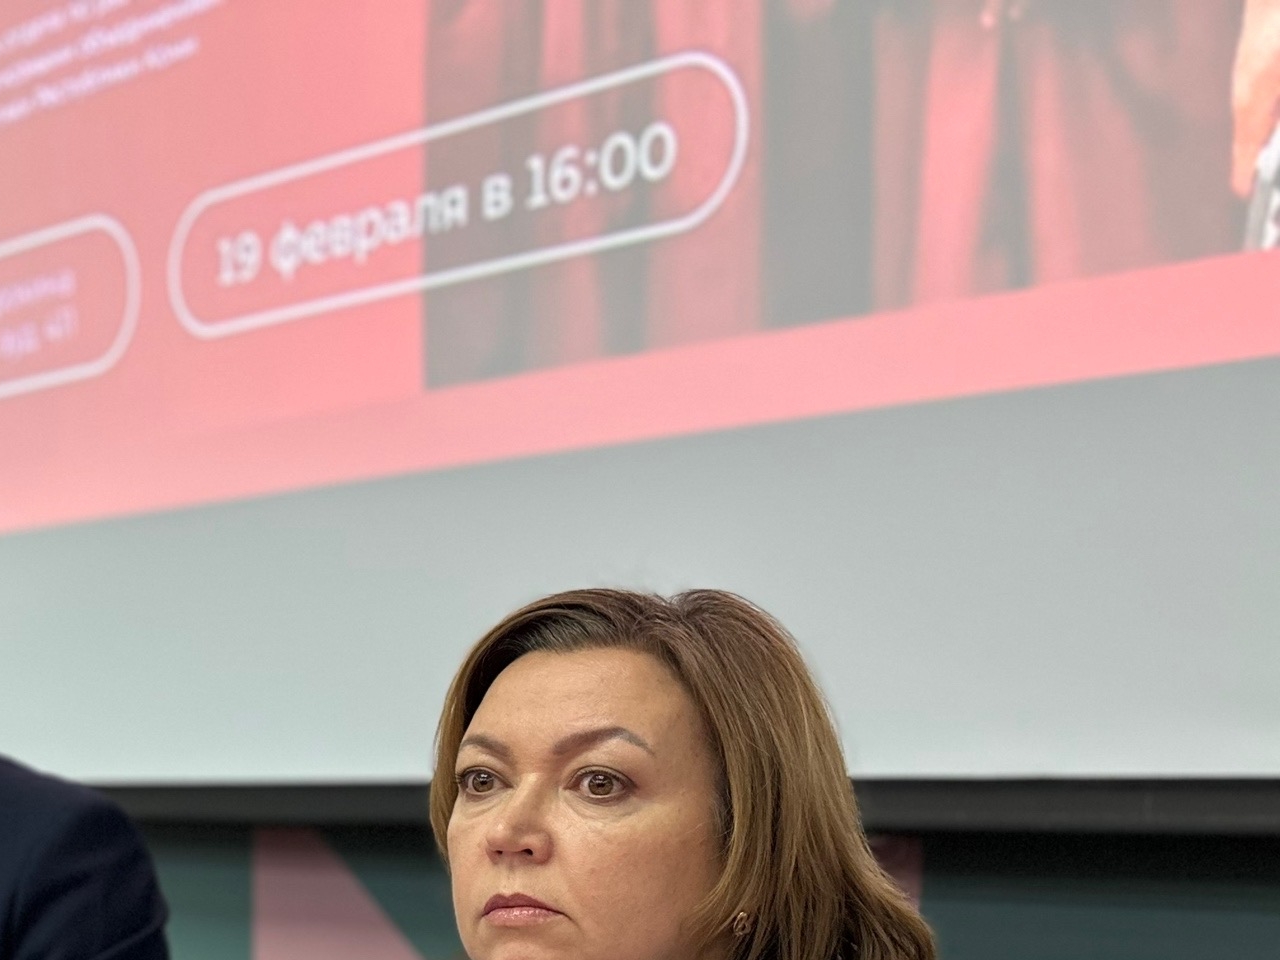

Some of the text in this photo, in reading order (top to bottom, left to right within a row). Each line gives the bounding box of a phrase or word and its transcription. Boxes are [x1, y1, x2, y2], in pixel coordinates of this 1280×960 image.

[216, 121, 679, 288] 19 февраля в 16:00
